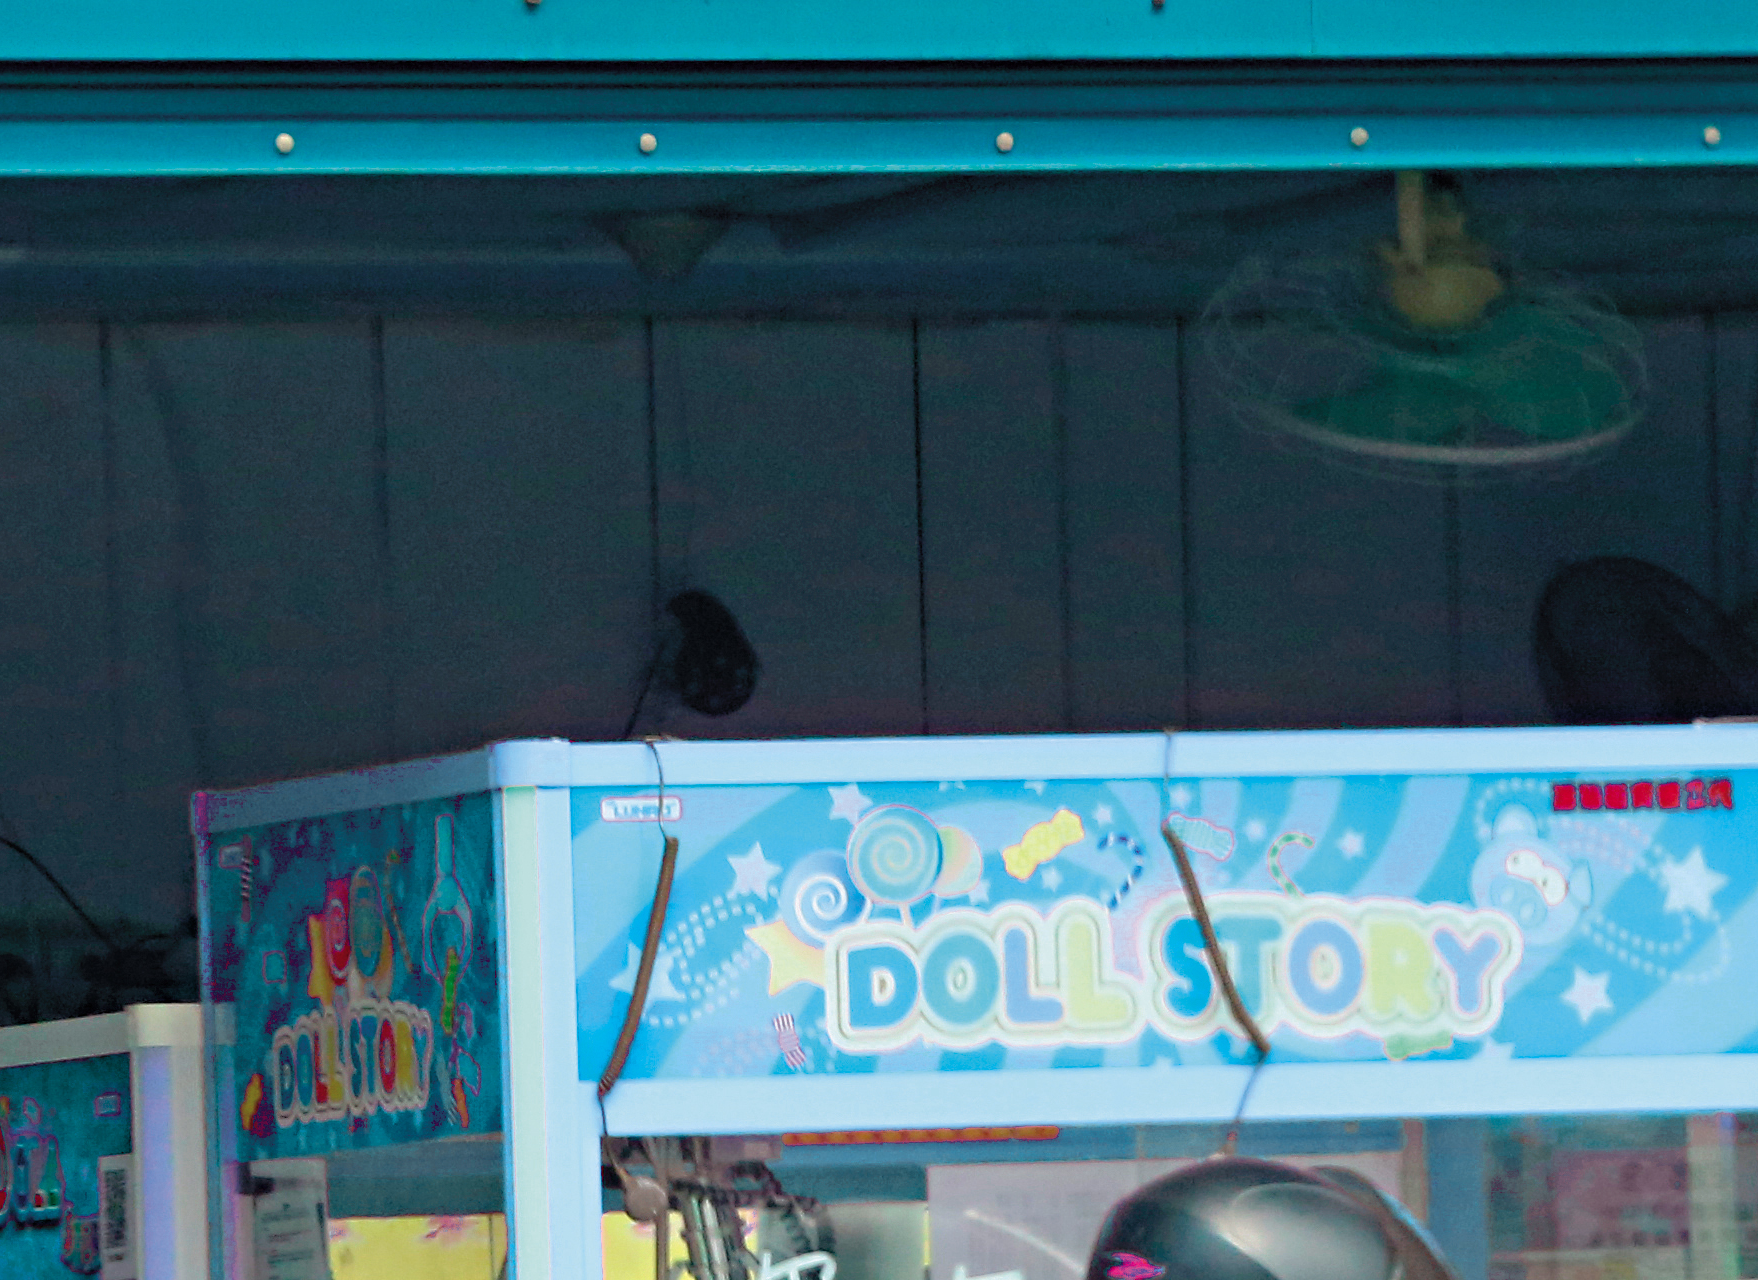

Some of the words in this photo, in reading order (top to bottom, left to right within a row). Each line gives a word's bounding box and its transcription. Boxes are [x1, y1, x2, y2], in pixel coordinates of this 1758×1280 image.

[841, 906, 1135, 1032] DOLL
[1157, 906, 1515, 1028] STORY
[277, 1026, 343, 1114] DOLL
